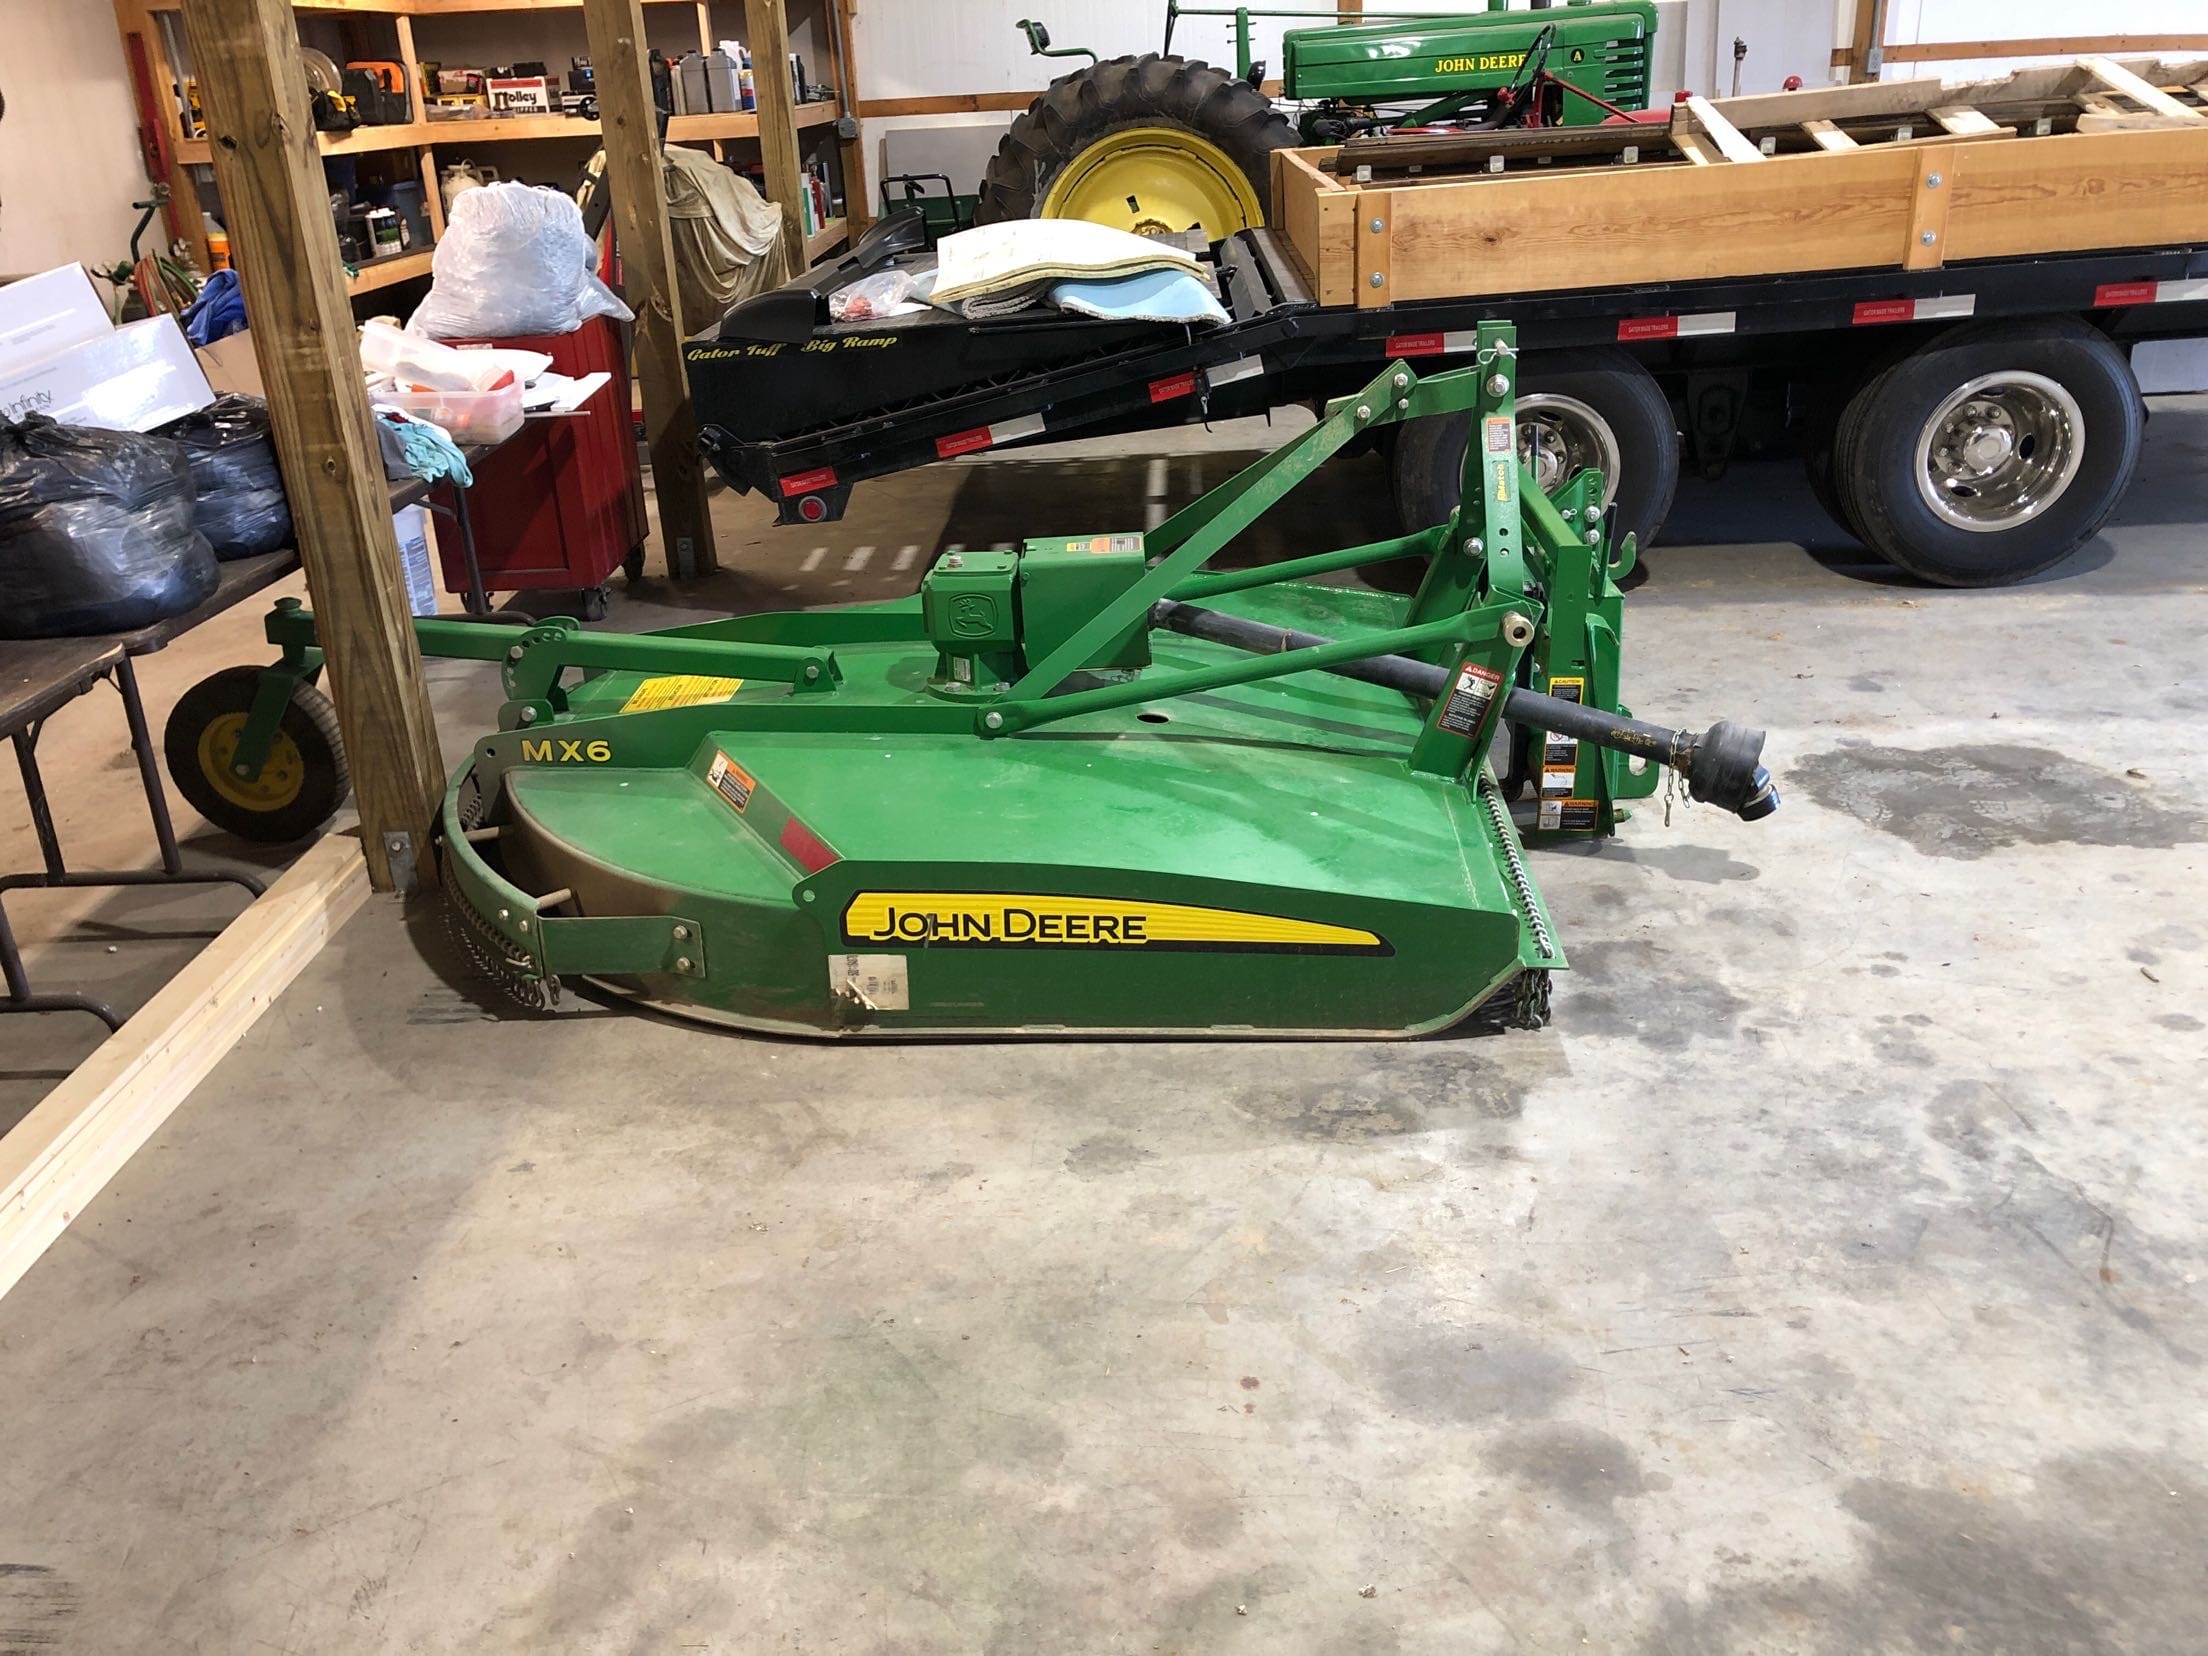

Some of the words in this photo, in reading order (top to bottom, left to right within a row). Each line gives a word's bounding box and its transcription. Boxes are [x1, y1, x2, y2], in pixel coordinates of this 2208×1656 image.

[1572, 50, 1583, 62] A
[1435, 58, 1475, 73] JOHN
[687, 348, 740, 361] Gator
[746, 343, 787, 357] Tuff
[800, 339, 837, 353] Big
[843, 336, 898, 351] Ramp
[1472, 667, 1500, 681] DANGER
[521, 740, 612, 762] MX6
[873, 907, 991, 937] JOHN
[1004, 908, 1147, 940] DEERE
